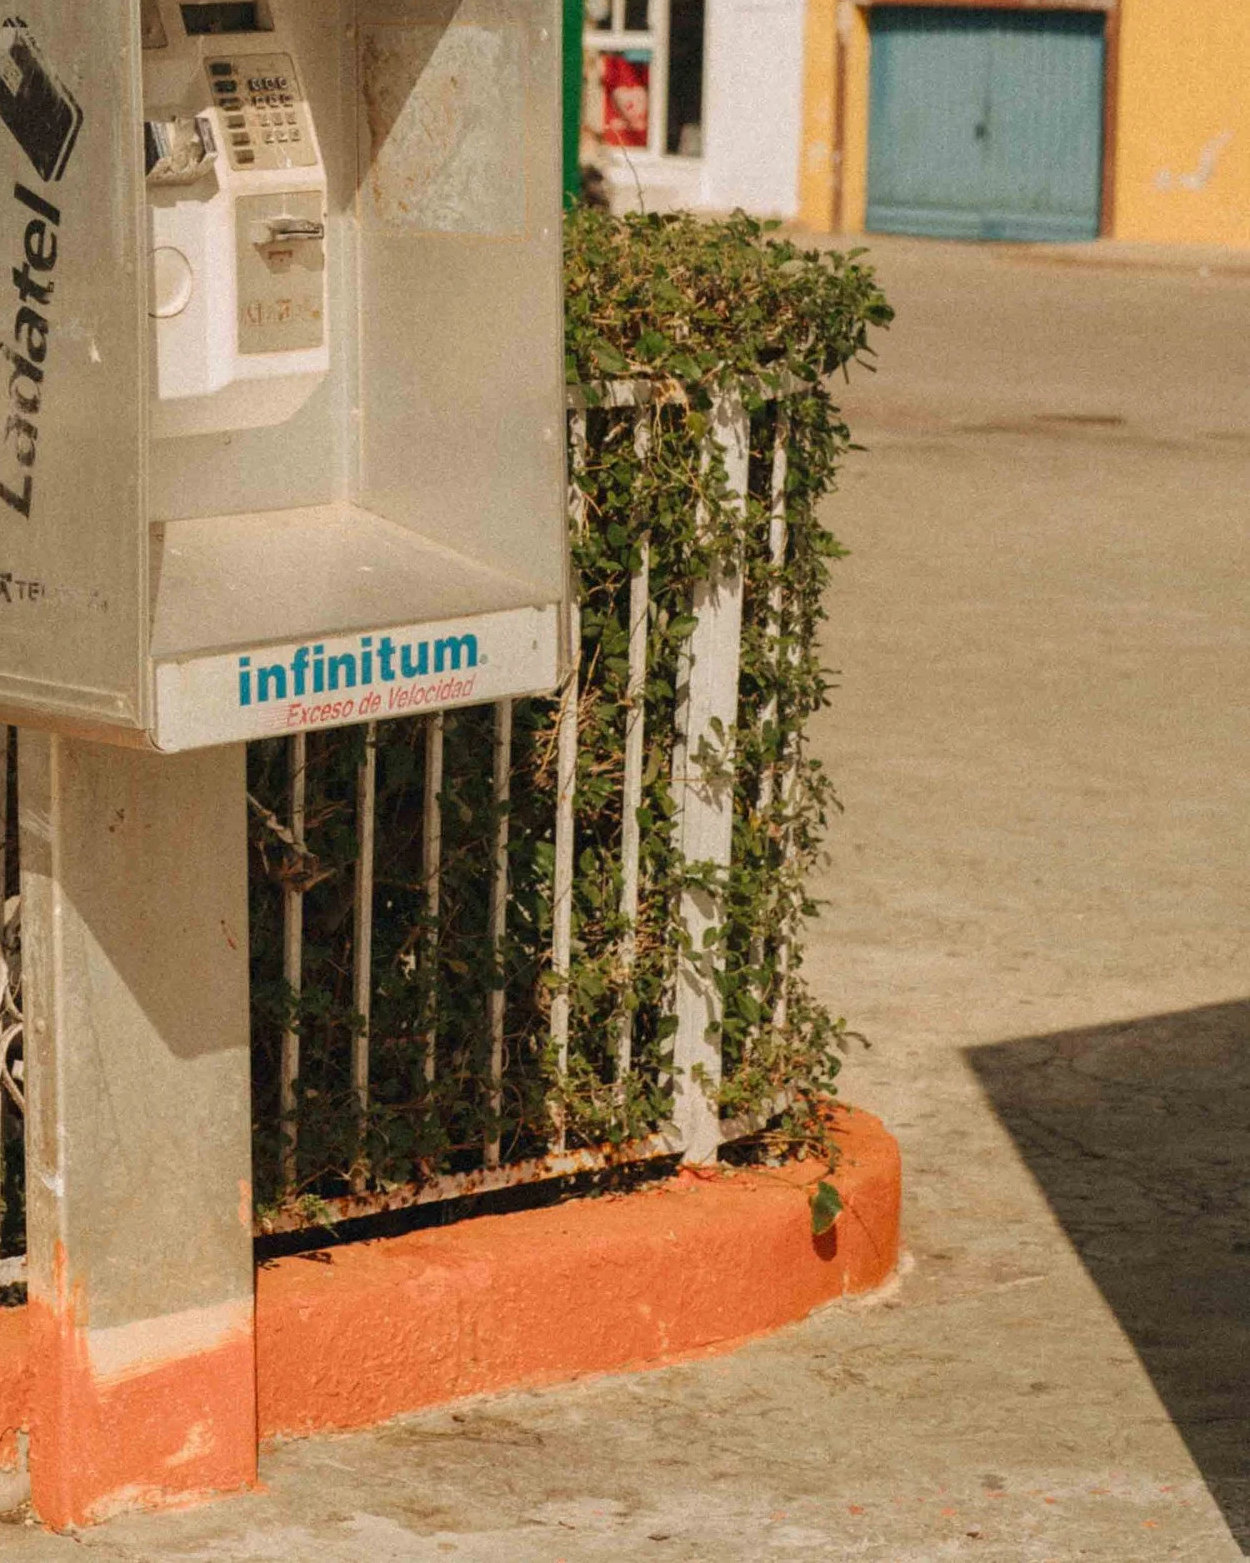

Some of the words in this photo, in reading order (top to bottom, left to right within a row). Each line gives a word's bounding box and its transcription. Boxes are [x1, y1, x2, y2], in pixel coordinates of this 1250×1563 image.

[239, 633, 478, 706] infinitum
[286, 698, 355, 728] Exceso
[359, 691, 382, 714] de
[388, 675, 476, 710] Velocidad
